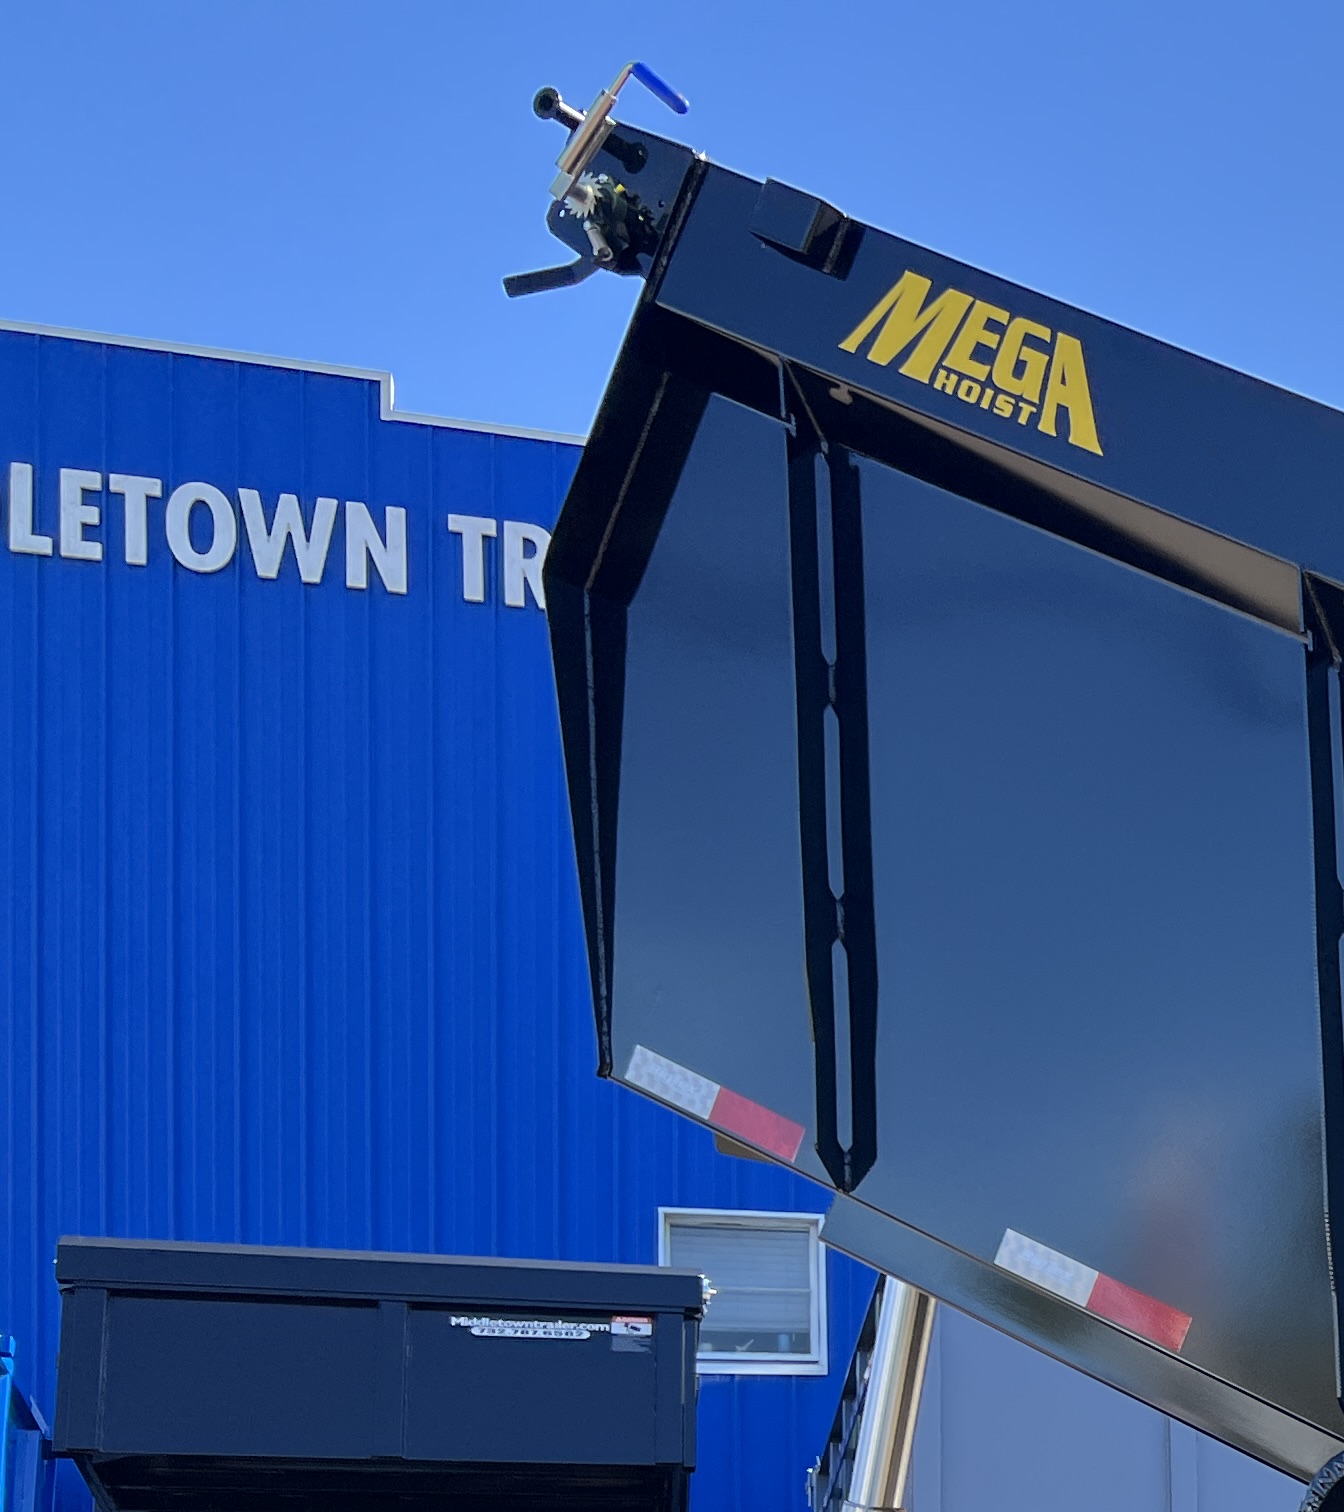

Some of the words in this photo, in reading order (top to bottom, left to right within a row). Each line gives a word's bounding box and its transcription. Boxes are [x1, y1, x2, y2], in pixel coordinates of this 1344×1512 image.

[837, 269, 1104, 457] MEGA
[932, 367, 1038, 426] HOIST
[8, 461, 408, 595] LETOWN
[450, 1315, 611, 1332] Middletowntrailer.com
